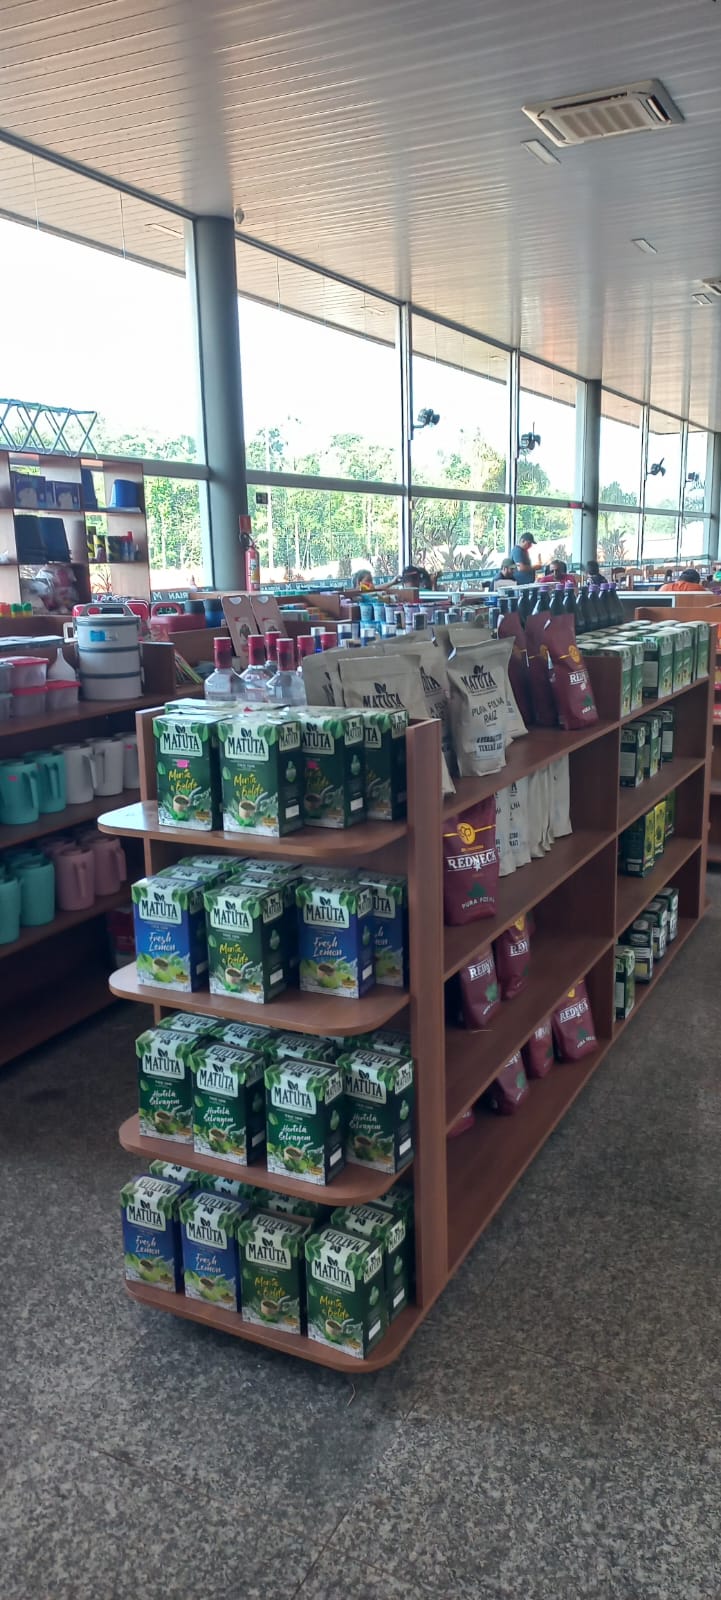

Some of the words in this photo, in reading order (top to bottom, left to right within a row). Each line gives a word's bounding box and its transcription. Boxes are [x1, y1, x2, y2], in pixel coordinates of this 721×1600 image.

[460, 672, 497, 691] MATUTA
[362, 694, 404, 709] MATUTA
[163, 732, 199, 750] MATUTA
[228, 736, 265, 755] MATUTA
[447, 850, 497, 869] REDNECK
[141, 899, 178, 919] MATUTA
[306, 903, 345, 922] MATUTA
[373, 896, 391, 912] UTA
[213, 907, 249, 926] MATUTA
[149, 931, 172, 944] Fresh
[149, 941, 176, 952] Lemon
[313, 936, 338, 948] Fresh
[219, 943, 242, 954] Menta
[313, 949, 342, 958] Lemon
[145, 1054, 181, 1074] MATUTA
[199, 1069, 234, 1091] MATUTA
[345, 1076, 383, 1097] MATUTA
[149, 1096, 180, 1111] Selvagem
[274, 1086, 313, 1108] MATUTA
[203, 1113, 234, 1126] Selvagem
[278, 1131, 311, 1146] Selvagem
[138, 1179, 177, 1195] MATUTA
[198, 1195, 237, 1212] MATUTA
[128, 1204, 163, 1225] MATUTA
[135, 1236, 157, 1247] Fresh
[188, 1221, 224, 1244] MATUTA
[323, 1231, 365, 1252] MATUTA
[195, 1253, 217, 1265] Fresh
[248, 1243, 287, 1263] MATUTA
[314, 1259, 352, 1285] MATUTA
